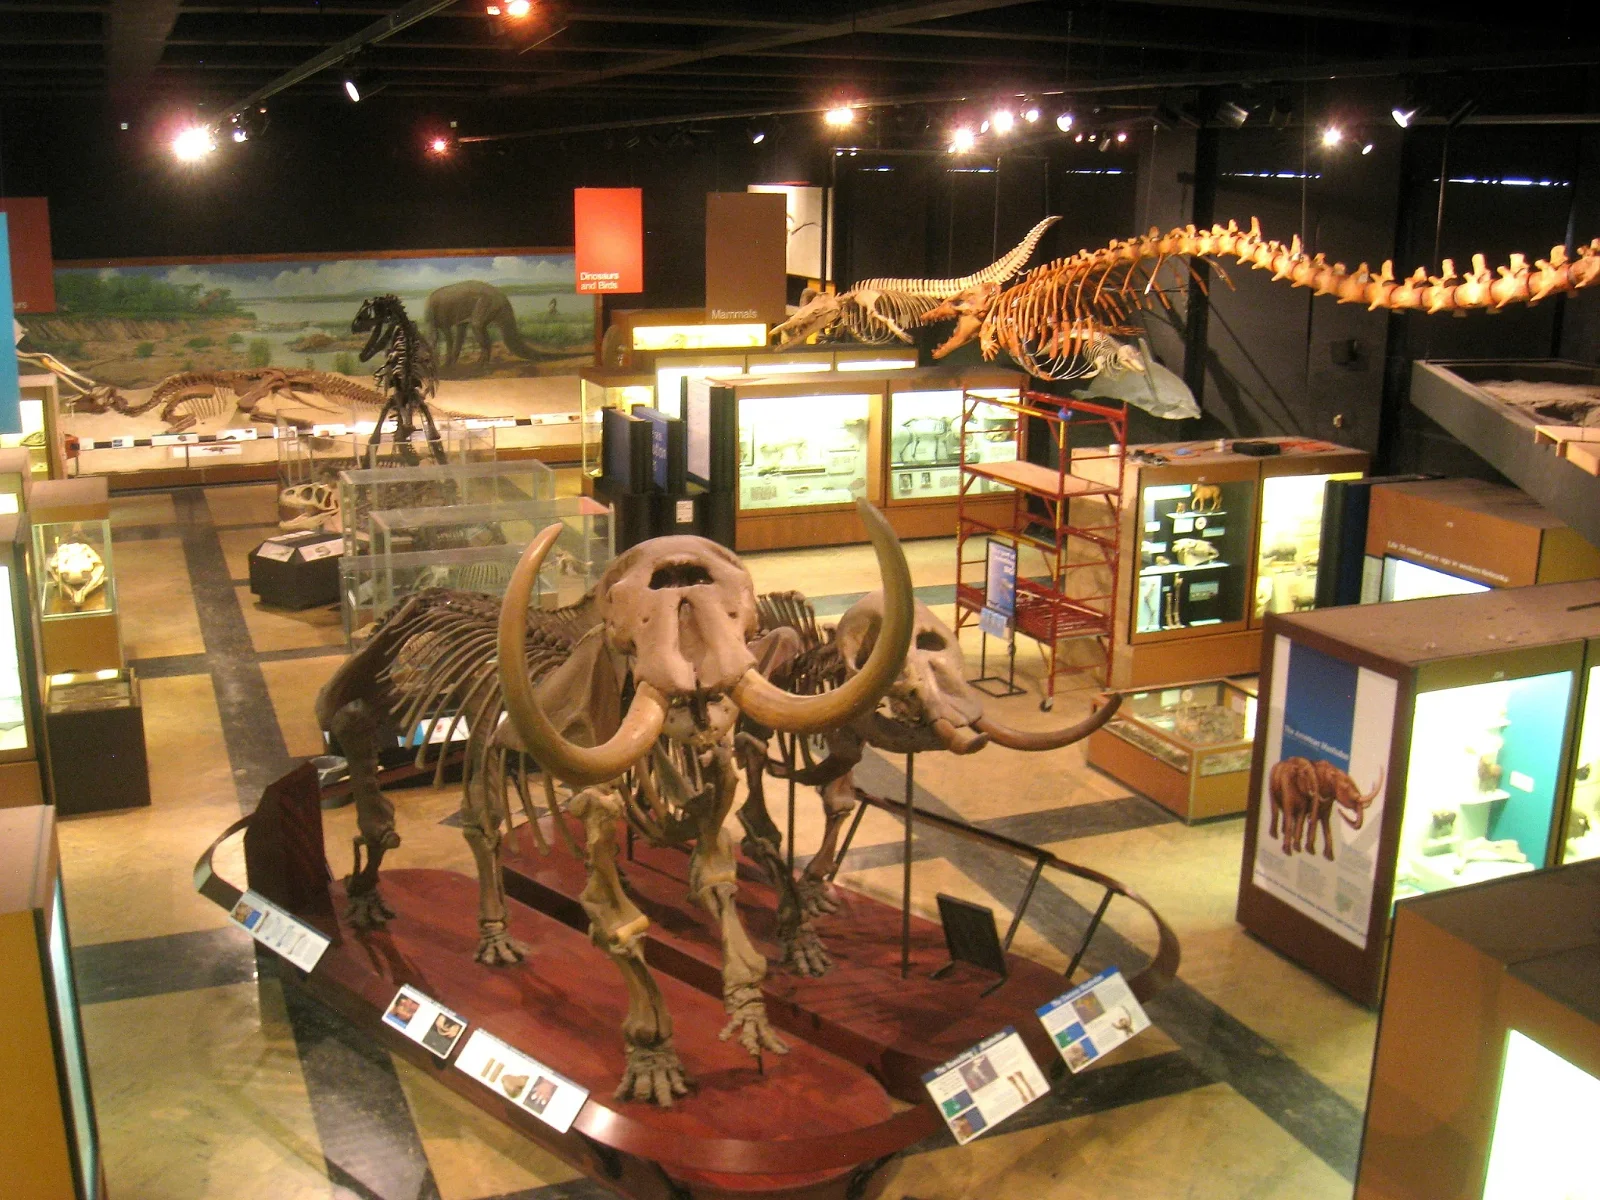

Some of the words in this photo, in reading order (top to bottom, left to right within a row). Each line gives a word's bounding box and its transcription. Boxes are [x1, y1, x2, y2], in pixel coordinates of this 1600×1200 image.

[580, 271, 619, 281] Dinosaurs
[581, 282, 596, 290] and
[598, 281, 618, 290] Birds
[711, 308, 757, 320] Mammals
[1423, 552, 1439, 562] years
[1439, 557, 1451, 566] ago
[1481, 568, 1509, 582] Nebraska
